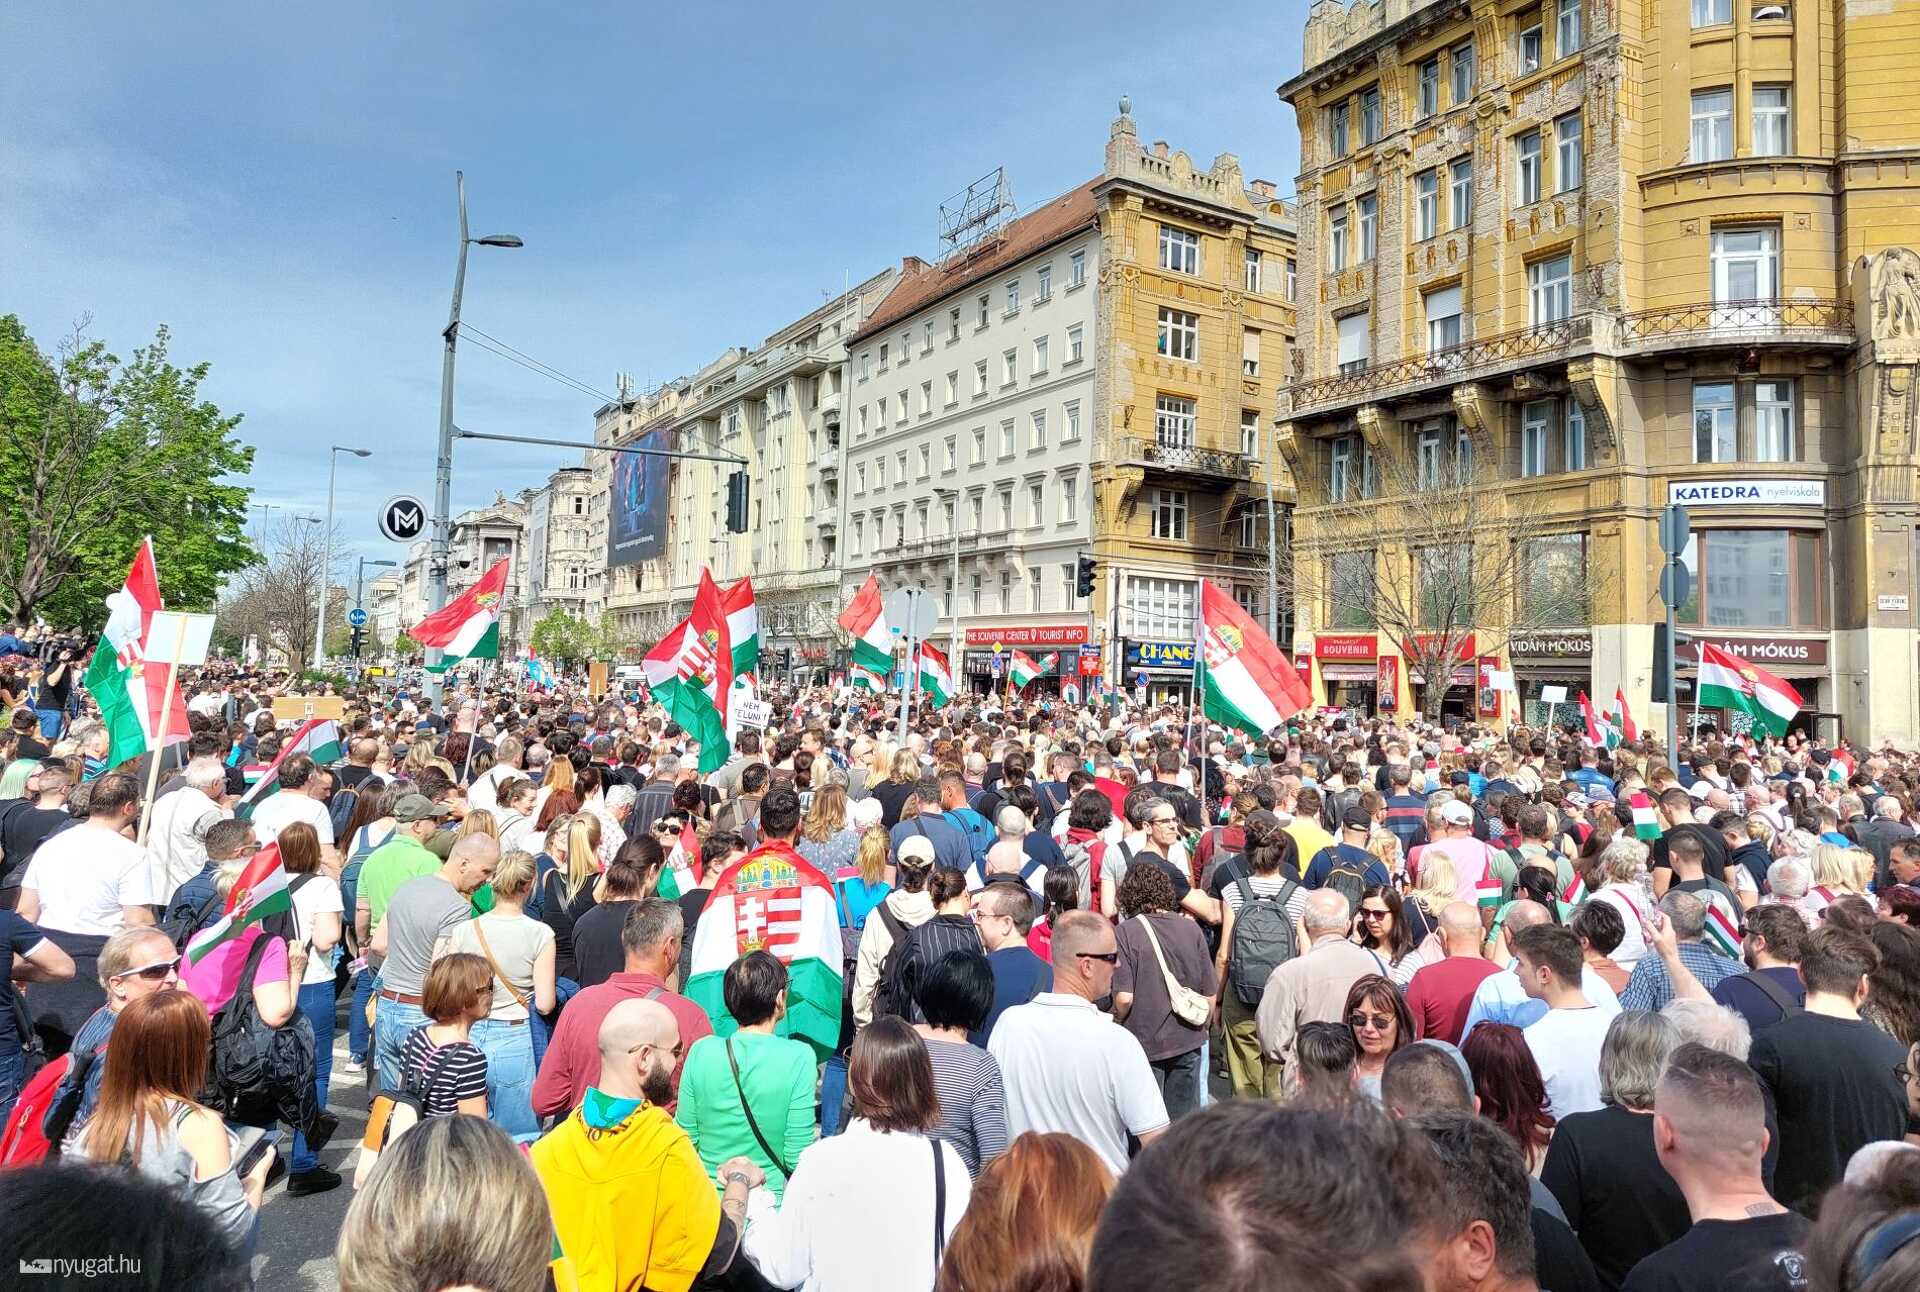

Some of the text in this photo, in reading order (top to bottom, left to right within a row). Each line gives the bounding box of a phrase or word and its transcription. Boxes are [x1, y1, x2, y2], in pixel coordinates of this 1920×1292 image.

[1676, 484, 1820, 500] KATEDRA nyelviskola
[1006, 630, 1029, 640] CENTER
[1039, 629, 1064, 640] TOURIST
[1066, 629, 1083, 639] INFO
[1140, 643, 1194, 660] CHANG
[1323, 646, 1369, 655] SOUVENIR
[1510, 639, 1592, 653] VIDÁM MÓKUS
[1752, 642, 1809, 659] MÓKUS
